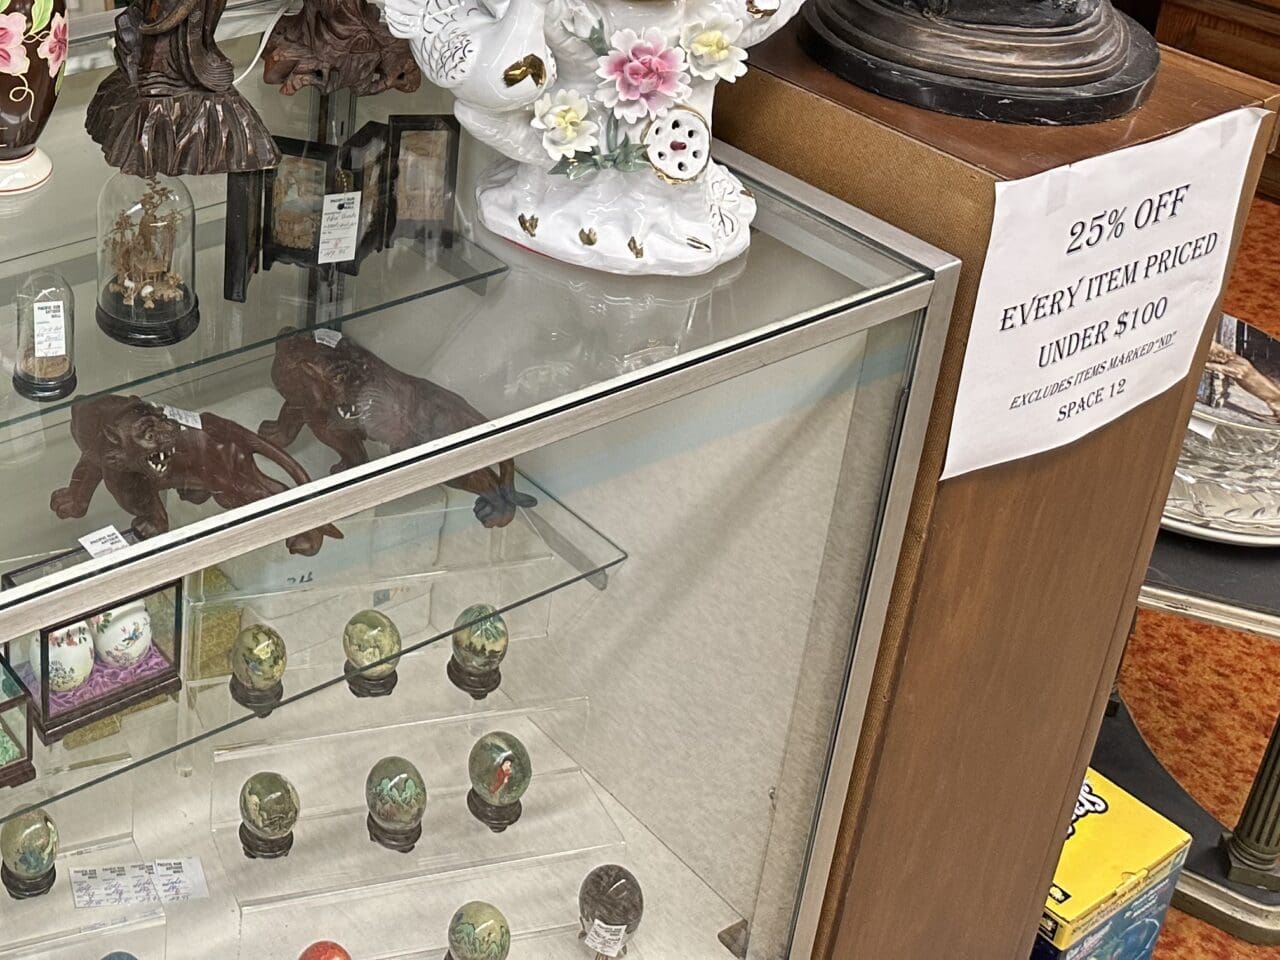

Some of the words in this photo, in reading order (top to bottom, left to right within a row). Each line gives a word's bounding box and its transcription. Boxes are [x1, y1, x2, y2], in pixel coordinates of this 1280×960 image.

[1065, 205, 1127, 255] 25%
[1134, 183, 1192, 230] OFF
[999, 276, 1084, 332] EVERY
[1085, 260, 1140, 303] ITEM
[1143, 231, 1219, 279] PRICED
[1037, 319, 1110, 368] UNDER
[1114, 296, 1169, 340] $100
[1008, 373, 1074, 410] EXCLUDES
[1073, 359, 1107, 386] ITEMS
[1057, 387, 1103, 423] SPACE
[1109, 377, 1127, 398] 12
